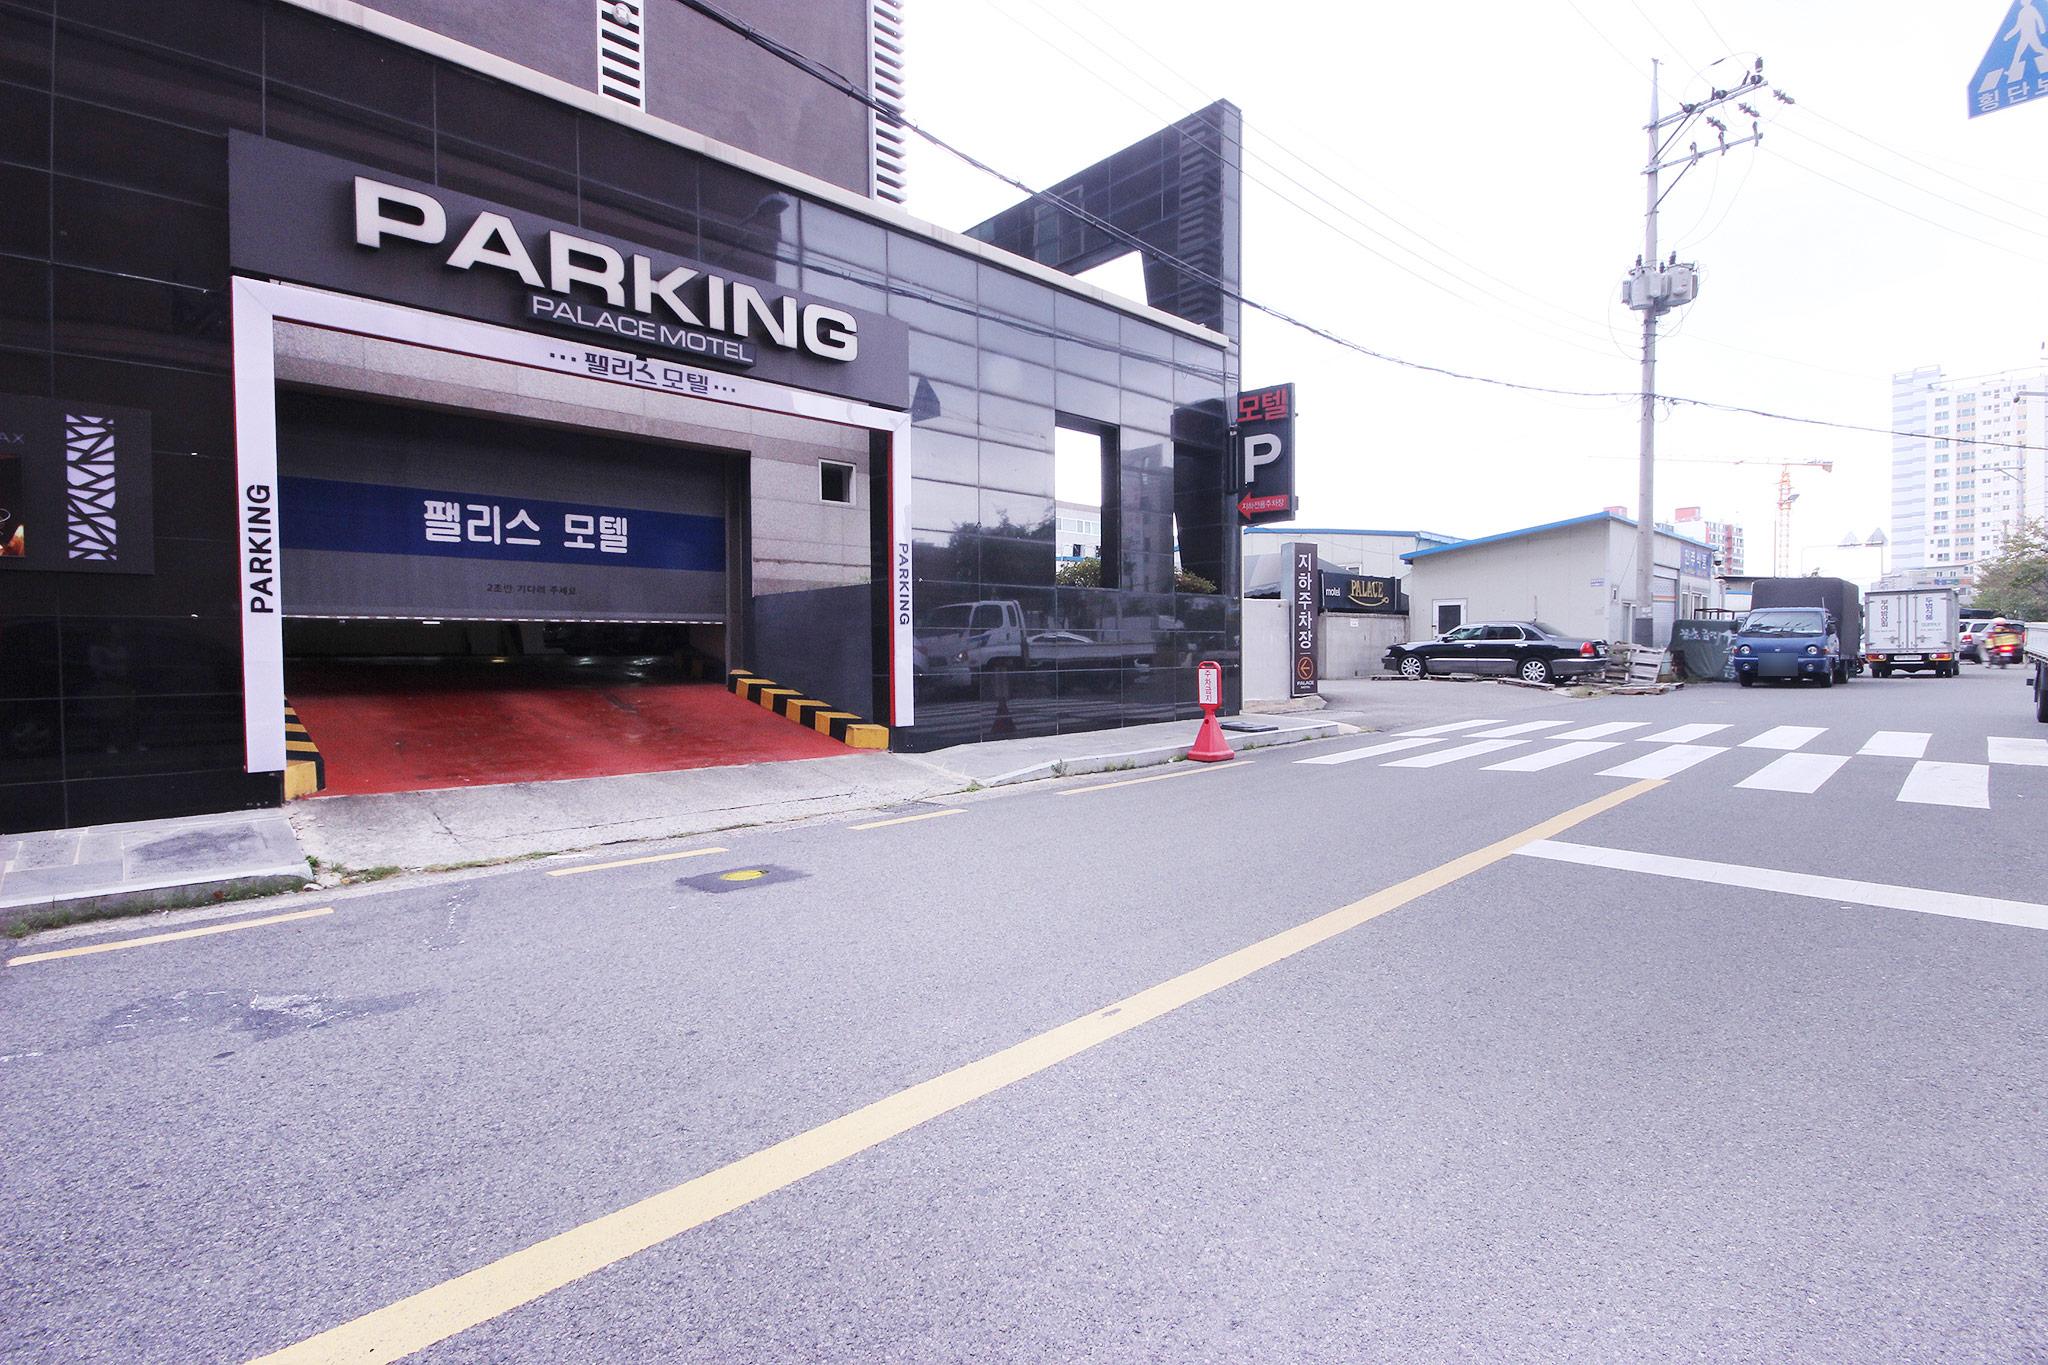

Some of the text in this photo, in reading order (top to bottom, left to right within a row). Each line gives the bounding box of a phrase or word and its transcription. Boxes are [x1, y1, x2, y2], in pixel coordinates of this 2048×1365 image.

[355, 176, 858, 362] PARKING
[532, 296, 754, 363] PALACE MOTEL
[662, 367, 708, 395] 모텔
[1236, 387, 1288, 422] 모텔
[1244, 433, 1282, 482] P
[246, 484, 273, 613] PARKING
[424, 500, 628, 553] 팰리스 모텔
[898, 543, 910, 625] PARKING
[1298, 552, 1313, 649] 지하주차장
[1325, 579, 1384, 598] motel PALACE
